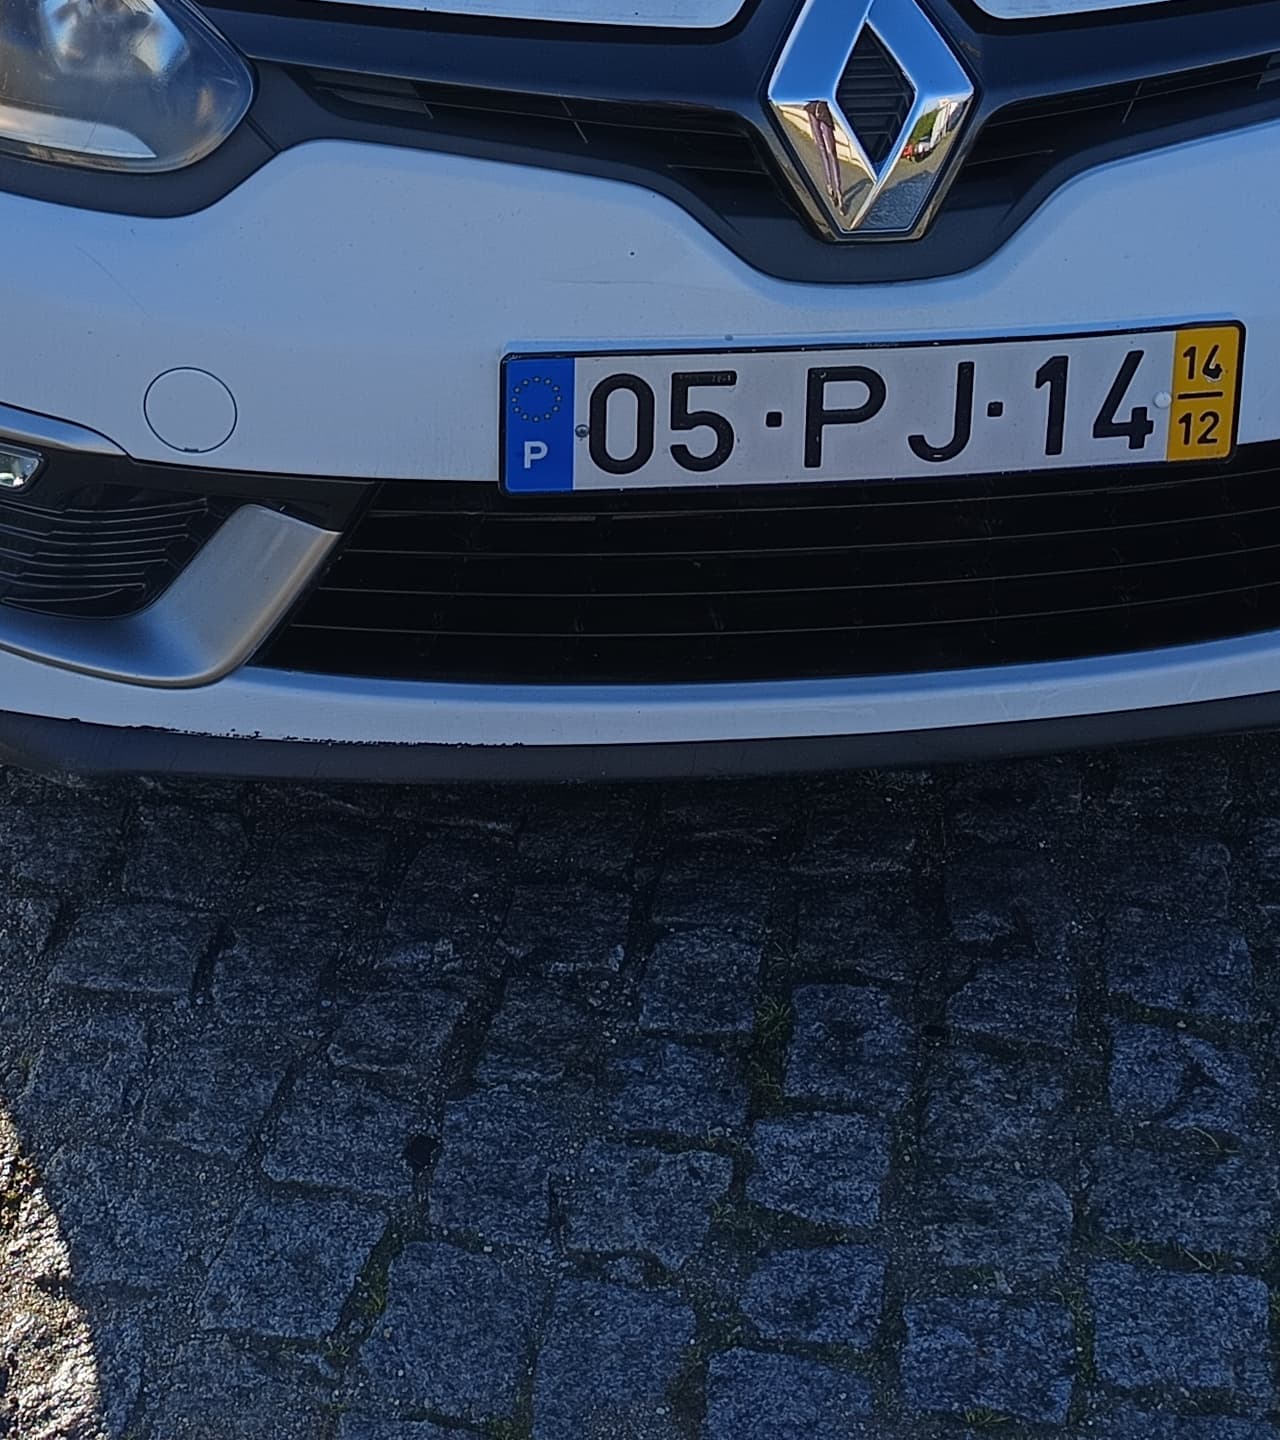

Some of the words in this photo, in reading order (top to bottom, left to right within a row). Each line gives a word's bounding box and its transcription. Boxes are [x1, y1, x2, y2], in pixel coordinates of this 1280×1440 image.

[1182, 345, 1224, 382] 14
[1176, 410, 1220, 447] 12
[524, 441, 549, 470] P
